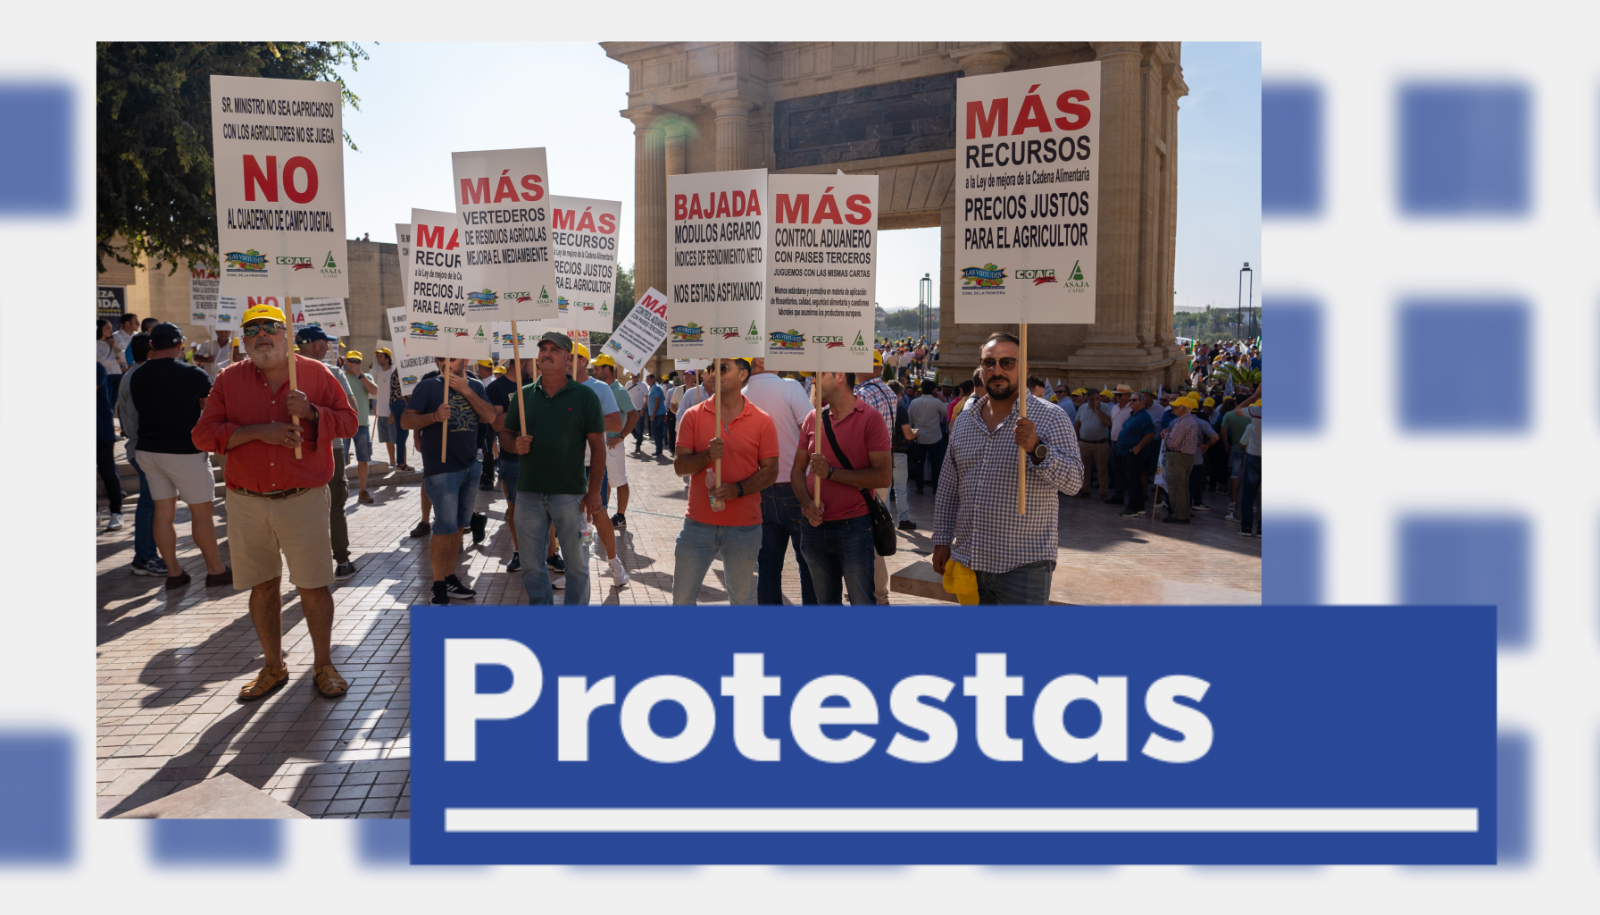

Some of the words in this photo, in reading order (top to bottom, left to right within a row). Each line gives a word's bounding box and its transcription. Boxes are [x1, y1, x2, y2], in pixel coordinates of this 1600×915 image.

[222, 97, 233, 113] SR.
[235, 98, 265, 115] MINISTRO
[267, 99, 276, 115] NO
[278, 100, 291, 116] SEA
[292, 101, 333, 118] CAPRICHOSO
[966, 84, 1091, 139] MÁS
[223, 123, 236, 139] CON
[238, 124, 249, 140] LOS
[251, 125, 295, 142] AGRICULTORES
[296, 127, 305, 142] NO
[307, 128, 314, 142] SE
[315, 128, 334, 143] JUEGA
[966, 135, 1091, 169] RECURSOS
[243, 154, 318, 204] NO
[460, 169, 544, 205] MÁS
[966, 179, 969, 189] a
[970, 175, 975, 188] la
[976, 176, 986, 191] Ley
[988, 175, 995, 187] de
[996, 173, 1015, 190] mejora
[1017, 173, 1024, 185] de
[1025, 172, 1031, 184] la
[1032, 169, 1054, 184] Cadena
[1055, 167, 1090, 183] Alimentaria
[675, 189, 761, 220] BAJADA
[775, 187, 872, 225] MÁS
[965, 194, 1026, 221] PRECIOS
[1031, 191, 1089, 218] JUSTOS
[228, 208, 236, 229] AL
[238, 209, 273, 230] CUADERNO
[275, 210, 284, 231] DE
[285, 210, 308, 231] CAMPO
[309, 211, 333, 232] DIGITAL
[463, 208, 545, 225] VERTEDEROS
[552, 206, 615, 234] MÁS
[465, 230, 474, 246] DE
[476, 228, 508, 245] RESIDUOS
[510, 224, 546, 243] AGRÍCOLAS
[552, 232, 614, 250] RECURSOS
[675, 220, 718, 244] MÓDULOS
[720, 221, 761, 242] AGRARIO
[775, 229, 818, 248] CONTROL
[820, 229, 871, 248] ADUANERO
[965, 227, 994, 249] PARA
[997, 226, 1010, 248] EL
[1013, 223, 1088, 248] AGRICULTOR
[277, 256, 311, 264] COAG
[416, 250, 461, 268] RECUR
[467, 249, 493, 266] MEJORA
[493, 249, 501, 264] EL
[502, 247, 548, 264] MEDIAMBIENTE
[675, 248, 696, 267] ÍNDICES
[698, 250, 706, 266] DE
[707, 249, 746, 266] RENDIMIENTO
[747, 247, 762, 264] NETO
[775, 252, 792, 263] CON
[794, 252, 823, 263] PAISES
[826, 252, 871, 264] TERCEROS
[555, 260, 581, 275] RECIOS
[583, 264, 612, 278] JUSTOS
[850, 270, 870, 278] CARTAS
[976, 270, 1002, 278] VIRTUDES
[1016, 269, 1054, 279] COAG
[414, 282, 453, 299] PRECIOS
[565, 278, 572, 290] EL
[573, 279, 611, 293] AGRICULTOR
[674, 284, 688, 303] NOS
[691, 283, 715, 303] ESTAIS
[717, 281, 762, 301] ASFIXIANDO!
[413, 299, 432, 313] PARA
[434, 301, 442, 315] EL
[443, 302, 465, 316] AGRIC
[641, 295, 667, 321] MÁ
